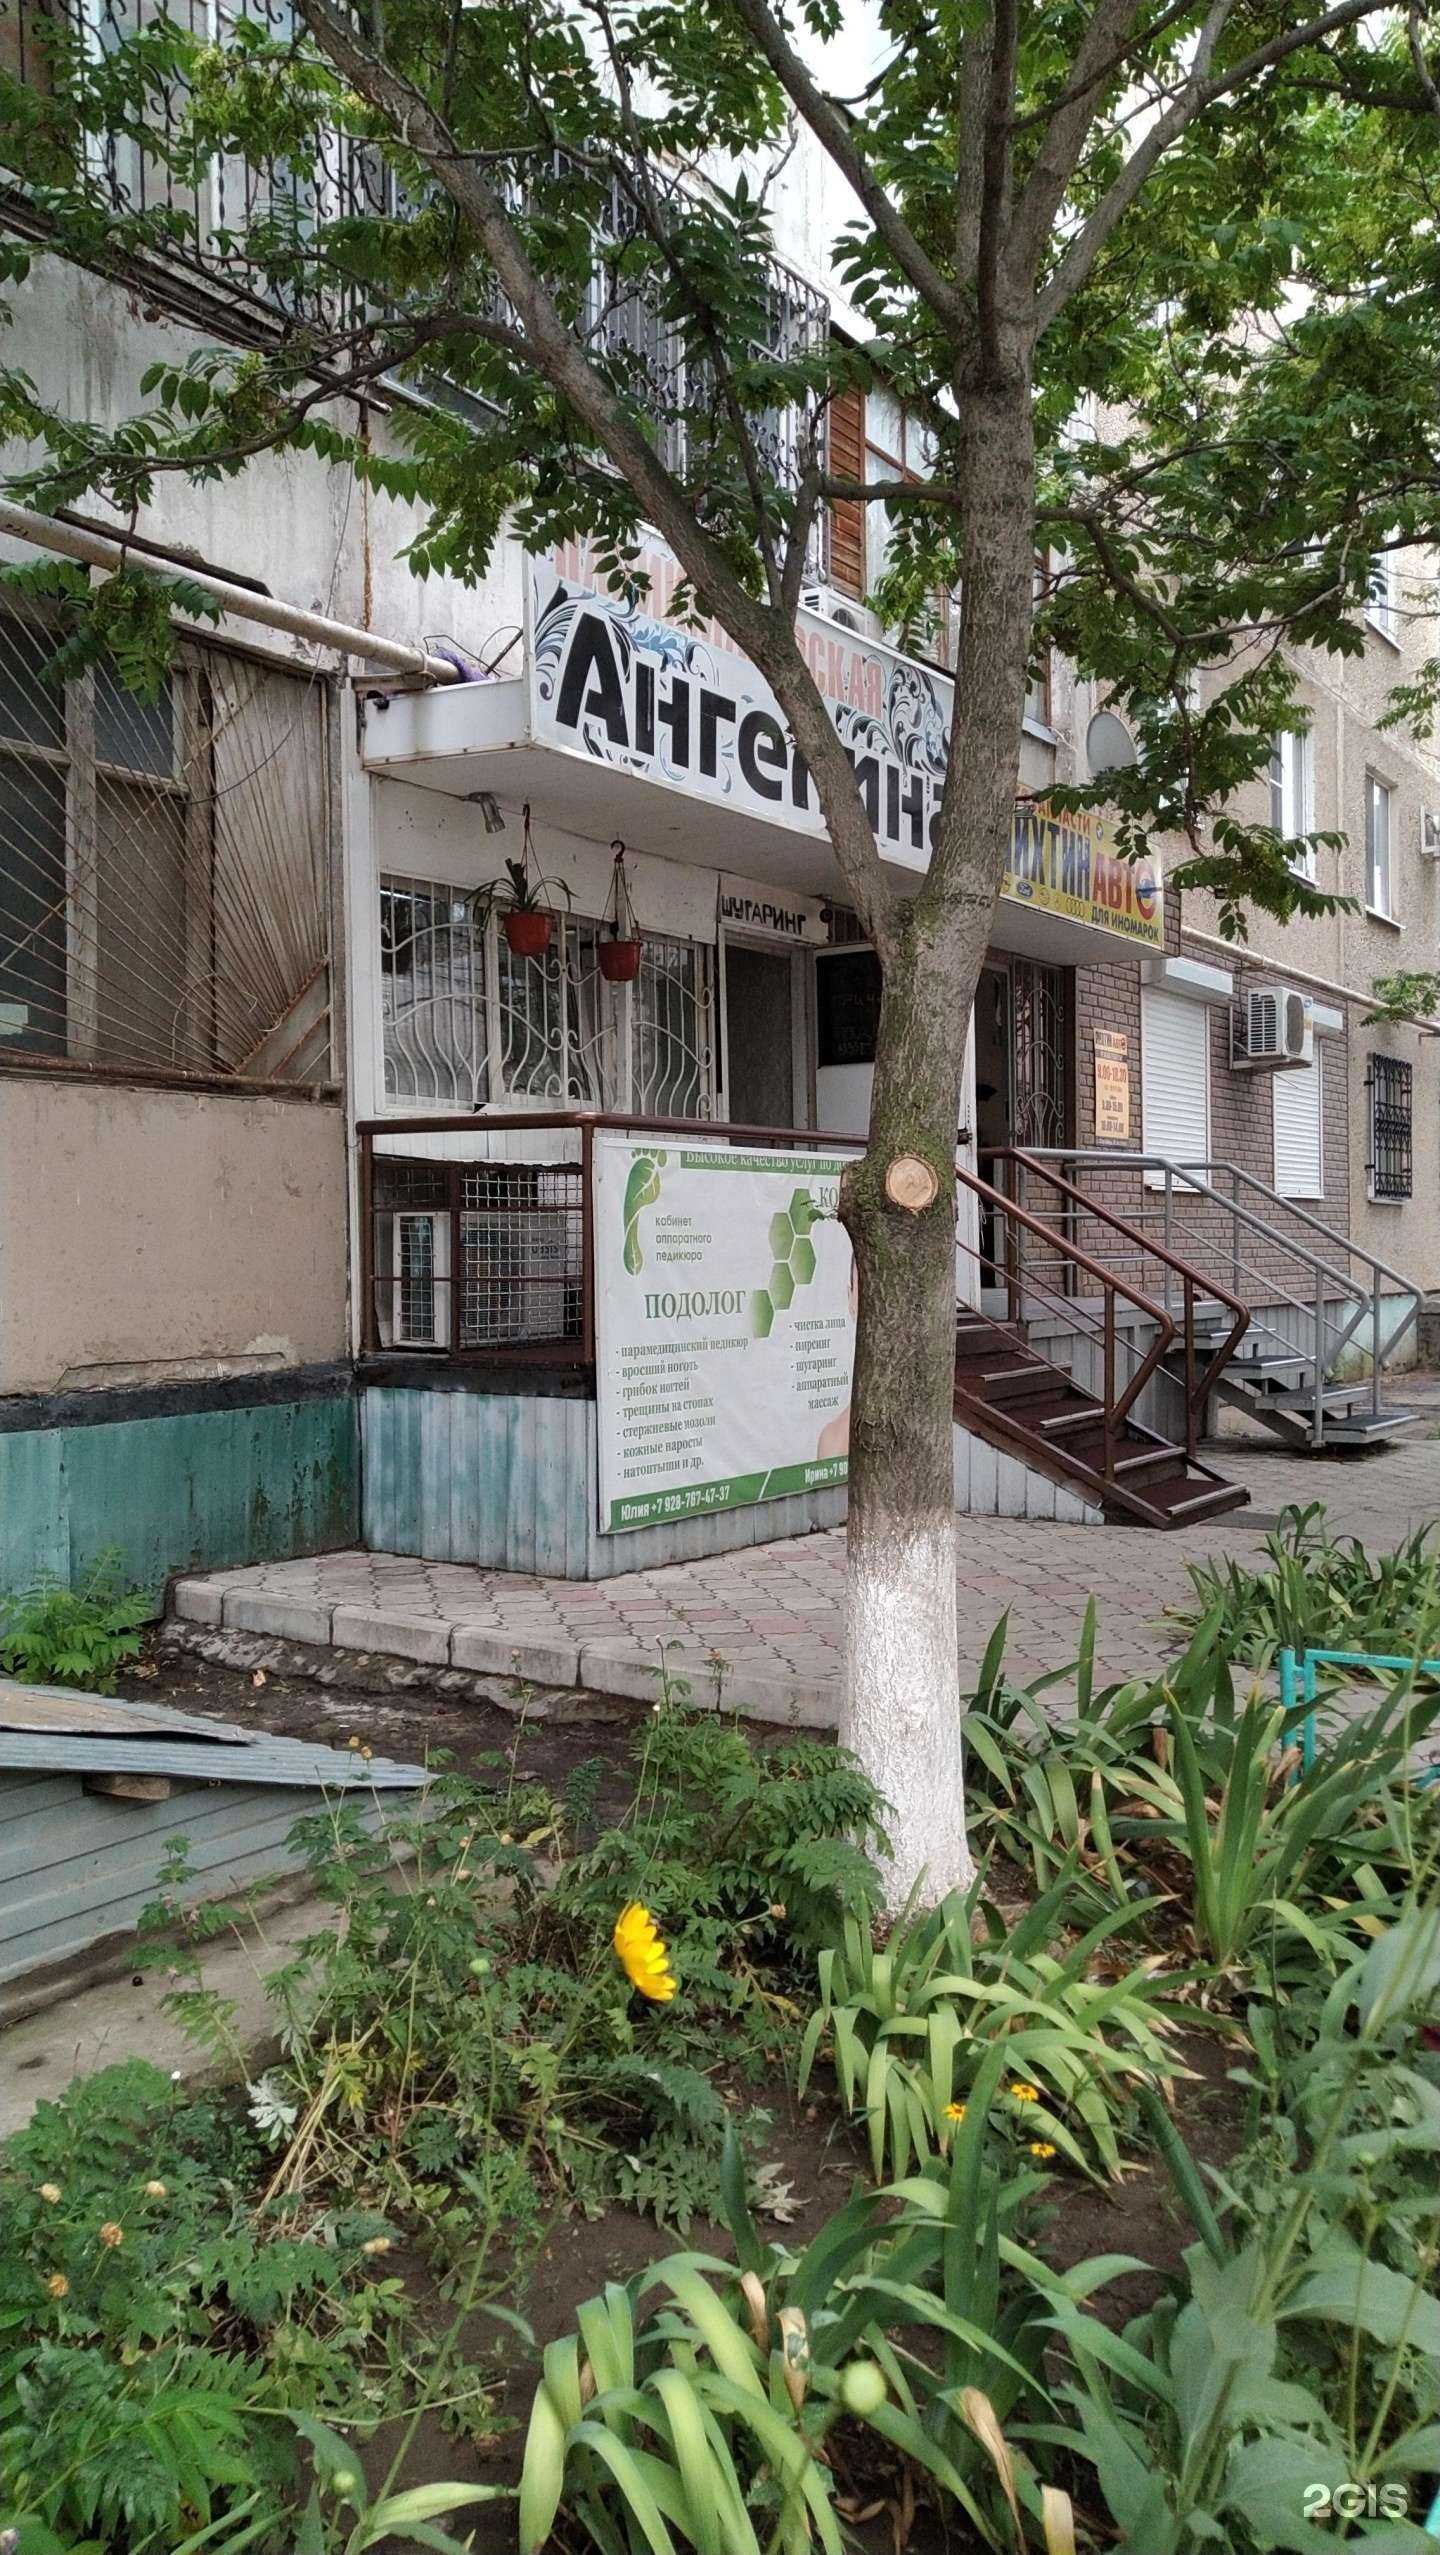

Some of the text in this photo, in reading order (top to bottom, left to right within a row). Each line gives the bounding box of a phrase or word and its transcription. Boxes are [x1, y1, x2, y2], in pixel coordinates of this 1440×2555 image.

[721, 895, 807, 934] ШУГАРИНГ
[1091, 905, 1159, 942] ДЛЯ ИНОМАРОК
[818, 1186, 839, 1208] КО
[655, 1215, 692, 1227] кабинет
[655, 1234, 712, 1246] аппаратного
[656, 1250, 703, 1263] педикюра
[644, 1290, 746, 1322] ПОДОЛОГ
[794, 1318, 846, 1331] чистка лица
[621, 1337, 749, 1360] парамедицинский педикюр
[795, 1338, 831, 1354] пирсинг
[622, 1361, 699, 1380] вросший ноготь
[796, 1358, 837, 1374] шугаринг
[622, 1377, 690, 1400] грибок ногтей
[796, 1371, 849, 1392] аппаратный
[623, 1397, 714, 1421] трещины на стопах
[808, 1396, 841, 1409] массаж
[622, 1415, 716, 1440] стержневые мозоли
[623, 1437, 703, 1458] кожные наросты
[623, 1455, 705, 1479] натоптыши и др.
[804, 1467, 829, 1486] Ирина
[621, 1503, 650, 1521] Юлия
